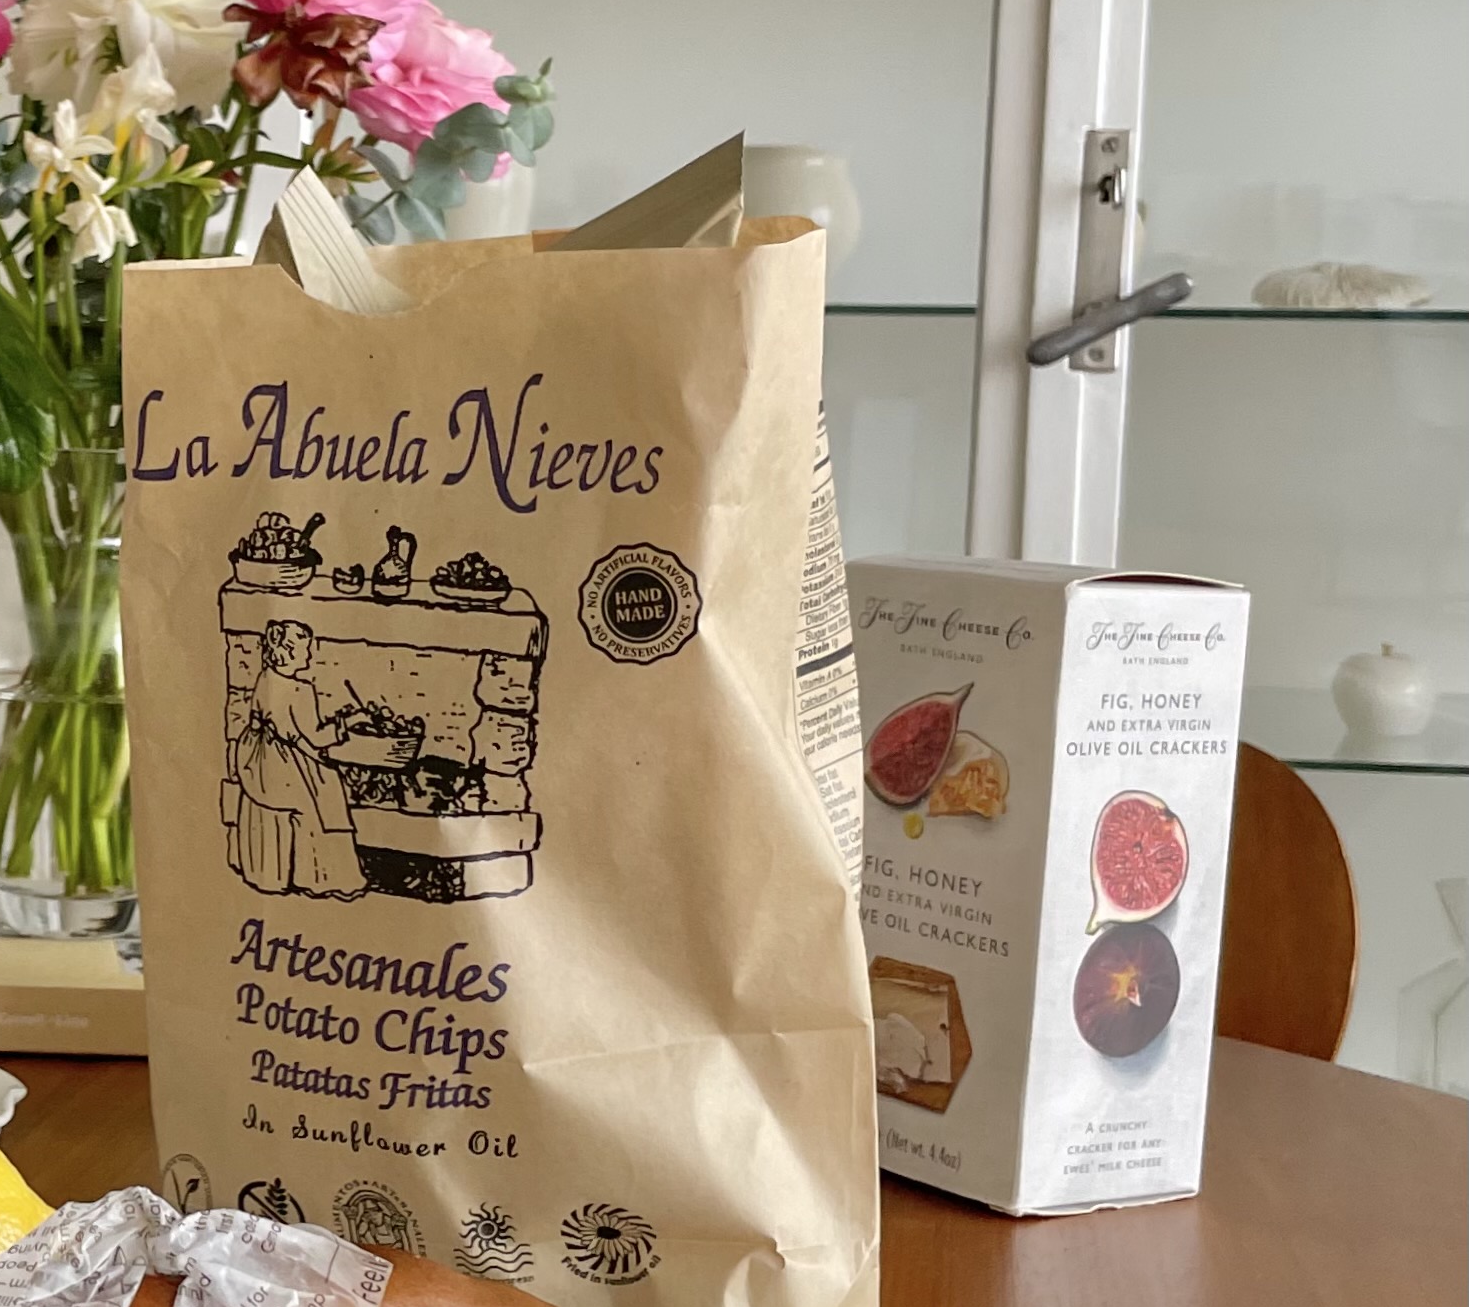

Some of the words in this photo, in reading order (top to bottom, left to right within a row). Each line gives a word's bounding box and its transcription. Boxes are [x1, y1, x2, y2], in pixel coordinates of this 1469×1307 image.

[132, 391, 218, 481] La
[232, 382, 429, 484] Abuela
[441, 374, 663, 513] Nieves
[587, 591, 598, 608] NO
[593, 553, 649, 589] ARTIFICIAL
[651, 556, 692, 598] FLAVORS
[615, 588, 662, 605] HAND
[616, 605, 665, 623] MADE
[592, 625, 607, 641] NO
[606, 615, 691, 657] PRESERVATIVES
[1101, 693, 1134, 712] FIG,
[1141, 693, 1202, 710] HONEY
[1086, 719, 1115, 733] AND
[1121, 719, 1163, 732] EXTRA
[1167, 718, 1211, 732] VIRGIN
[1066, 741, 1112, 756] OLIVE
[1117, 741, 1143, 755] OIL
[1149, 740, 1227, 755] CRACKERS
[909, 865, 983, 898] HONEY
[861, 883, 880, 899] ND
[887, 889, 933, 910] EXTRA
[940, 901, 993, 926] VIRGIN
[885, 913, 911, 934] OIL
[918, 922, 1010, 957] CRACKERS
[231, 918, 511, 1002] Artesanales
[236, 983, 360, 1046] Potato
[374, 1009, 509, 1073] Chips
[250, 1048, 371, 1101] Patatas
[378, 1072, 492, 1110] Fritas
[241, 1104, 275, 1134] In
[292, 1115, 447, 1158] Sunflower
[468, 1131, 519, 1158] Oil
[1085, 1122, 1093, 1134] A
[1118, 1141, 1137, 1151] FOR
[1141, 1139, 1162, 1149] ANY
[561, 1256, 589, 1279] Fried
[590, 1273, 602, 1284] in
[649, 1255, 662, 1270] oil
